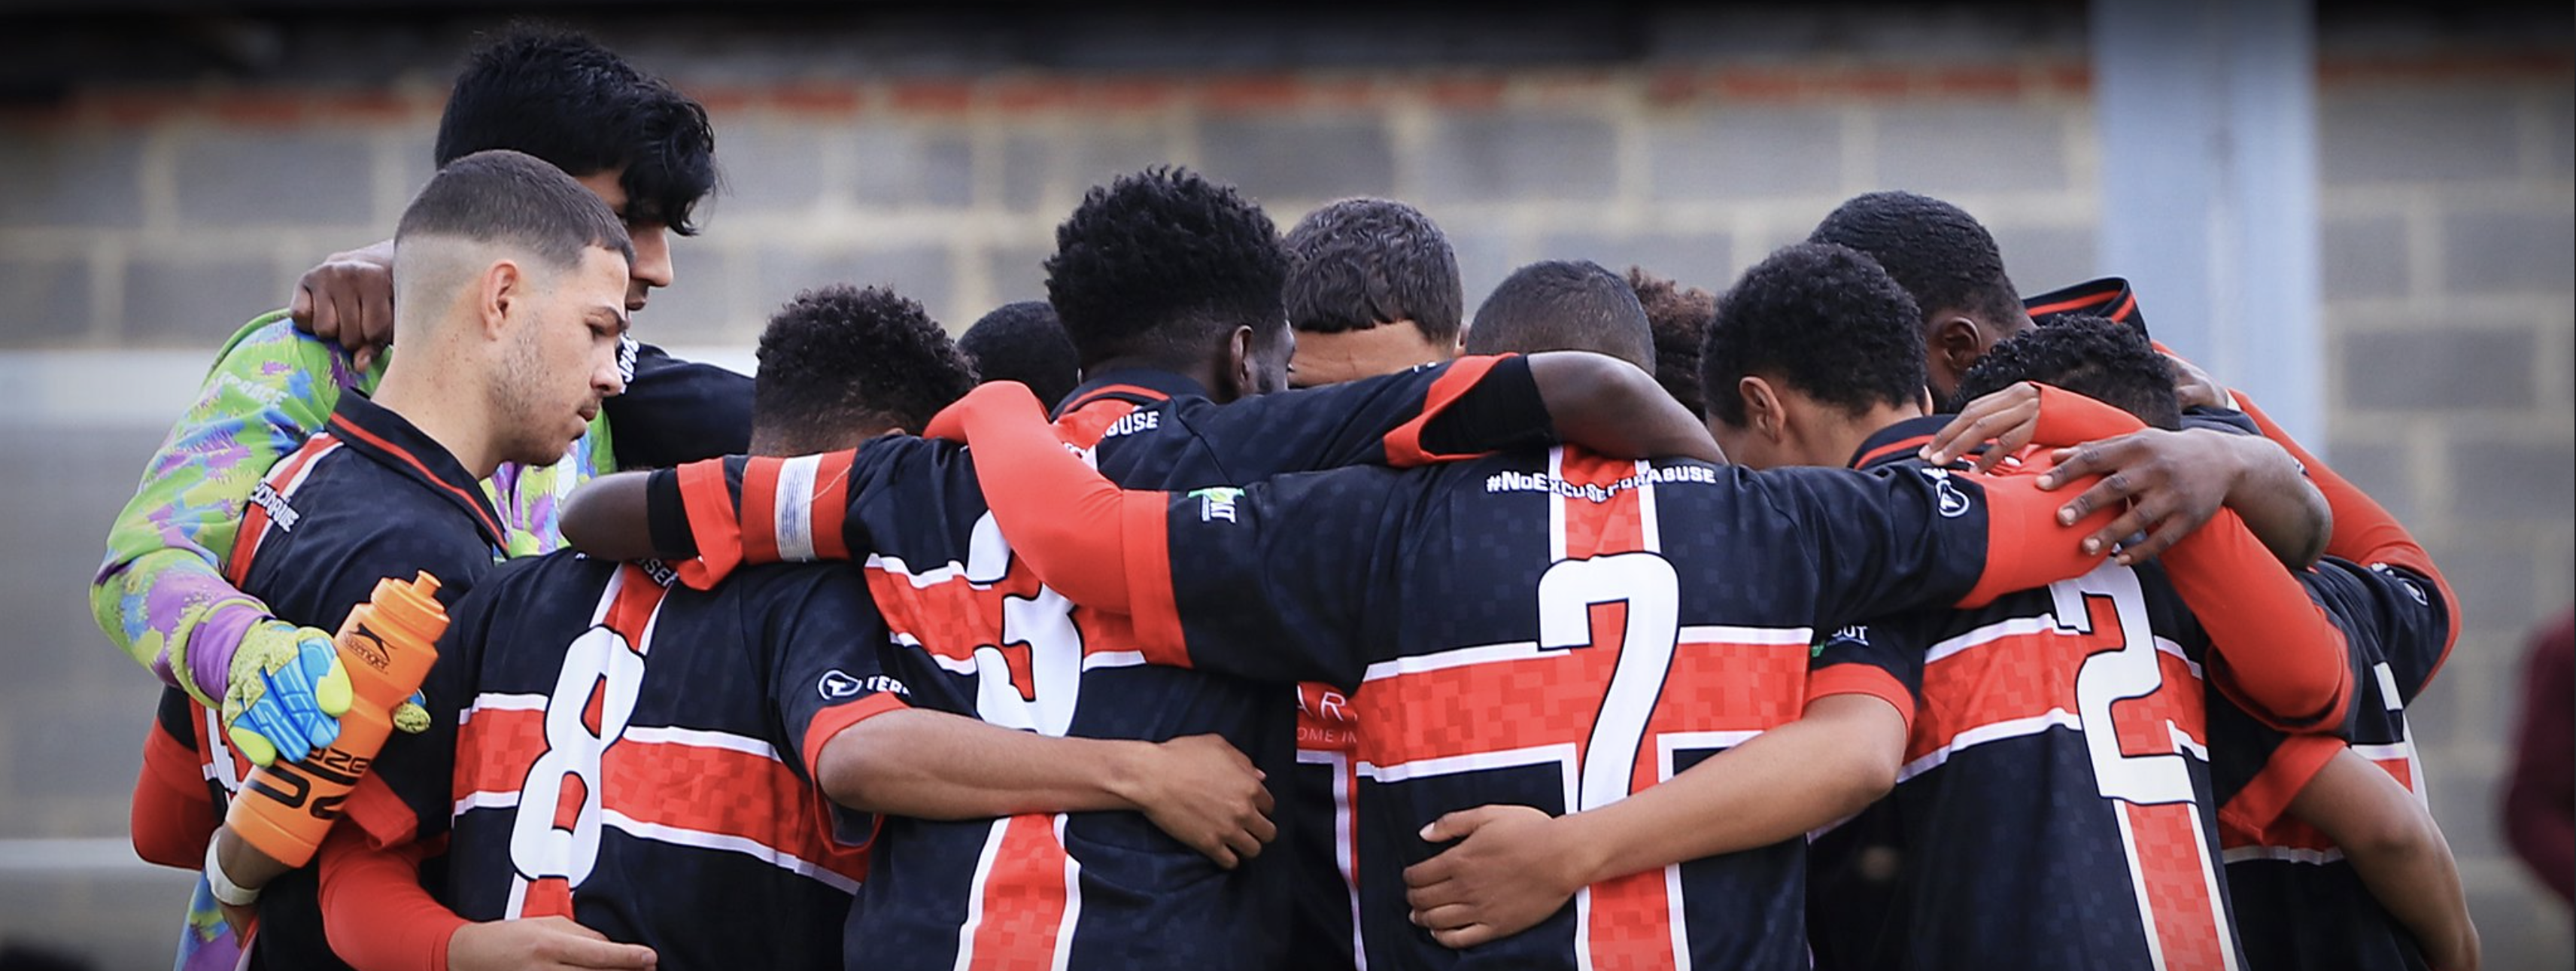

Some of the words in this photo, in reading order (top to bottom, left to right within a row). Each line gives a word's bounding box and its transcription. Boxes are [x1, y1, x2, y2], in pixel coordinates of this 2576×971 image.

[510, 625, 645, 890] 8
[1538, 552, 1679, 811] 7
[2048, 556, 2197, 804] 2
